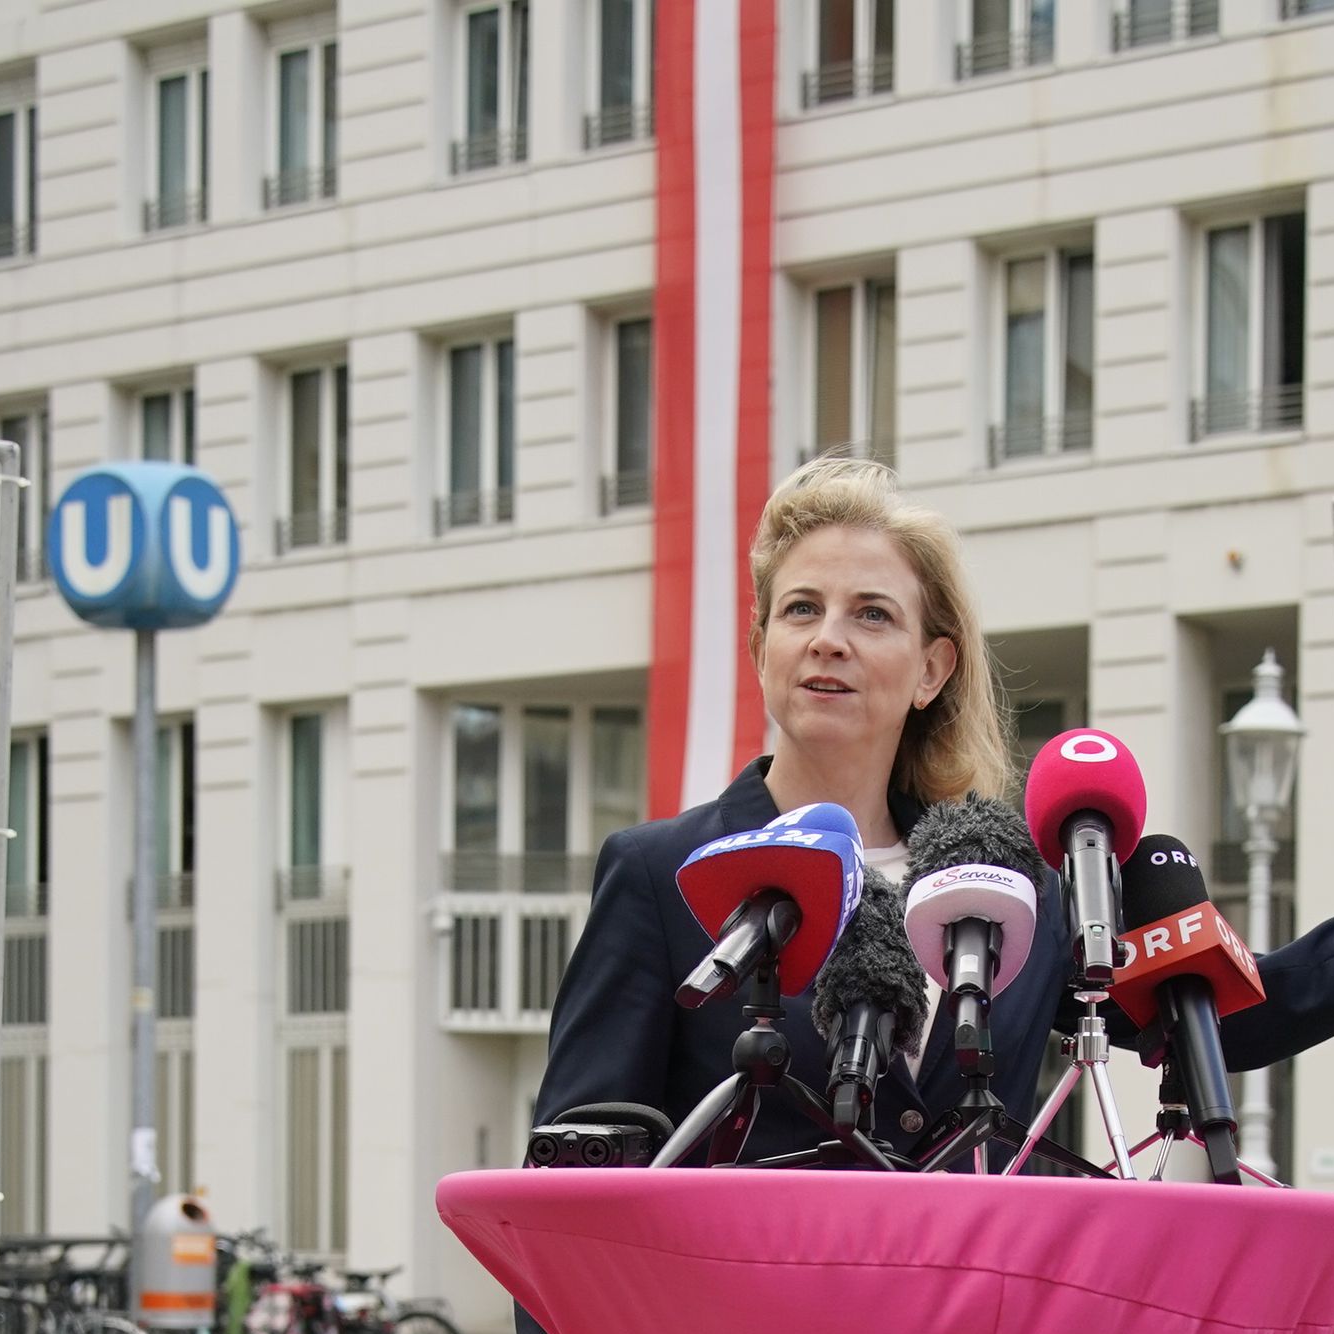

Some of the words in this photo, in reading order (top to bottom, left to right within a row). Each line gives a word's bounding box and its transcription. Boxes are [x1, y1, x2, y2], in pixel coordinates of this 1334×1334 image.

[61, 493, 132, 597] U
[170, 495, 230, 600] U
[700, 831, 774, 858] PULS
[775, 830, 822, 846] 24
[1150, 850, 1198, 868] ORF
[1215, 914, 1255, 975] ORF
